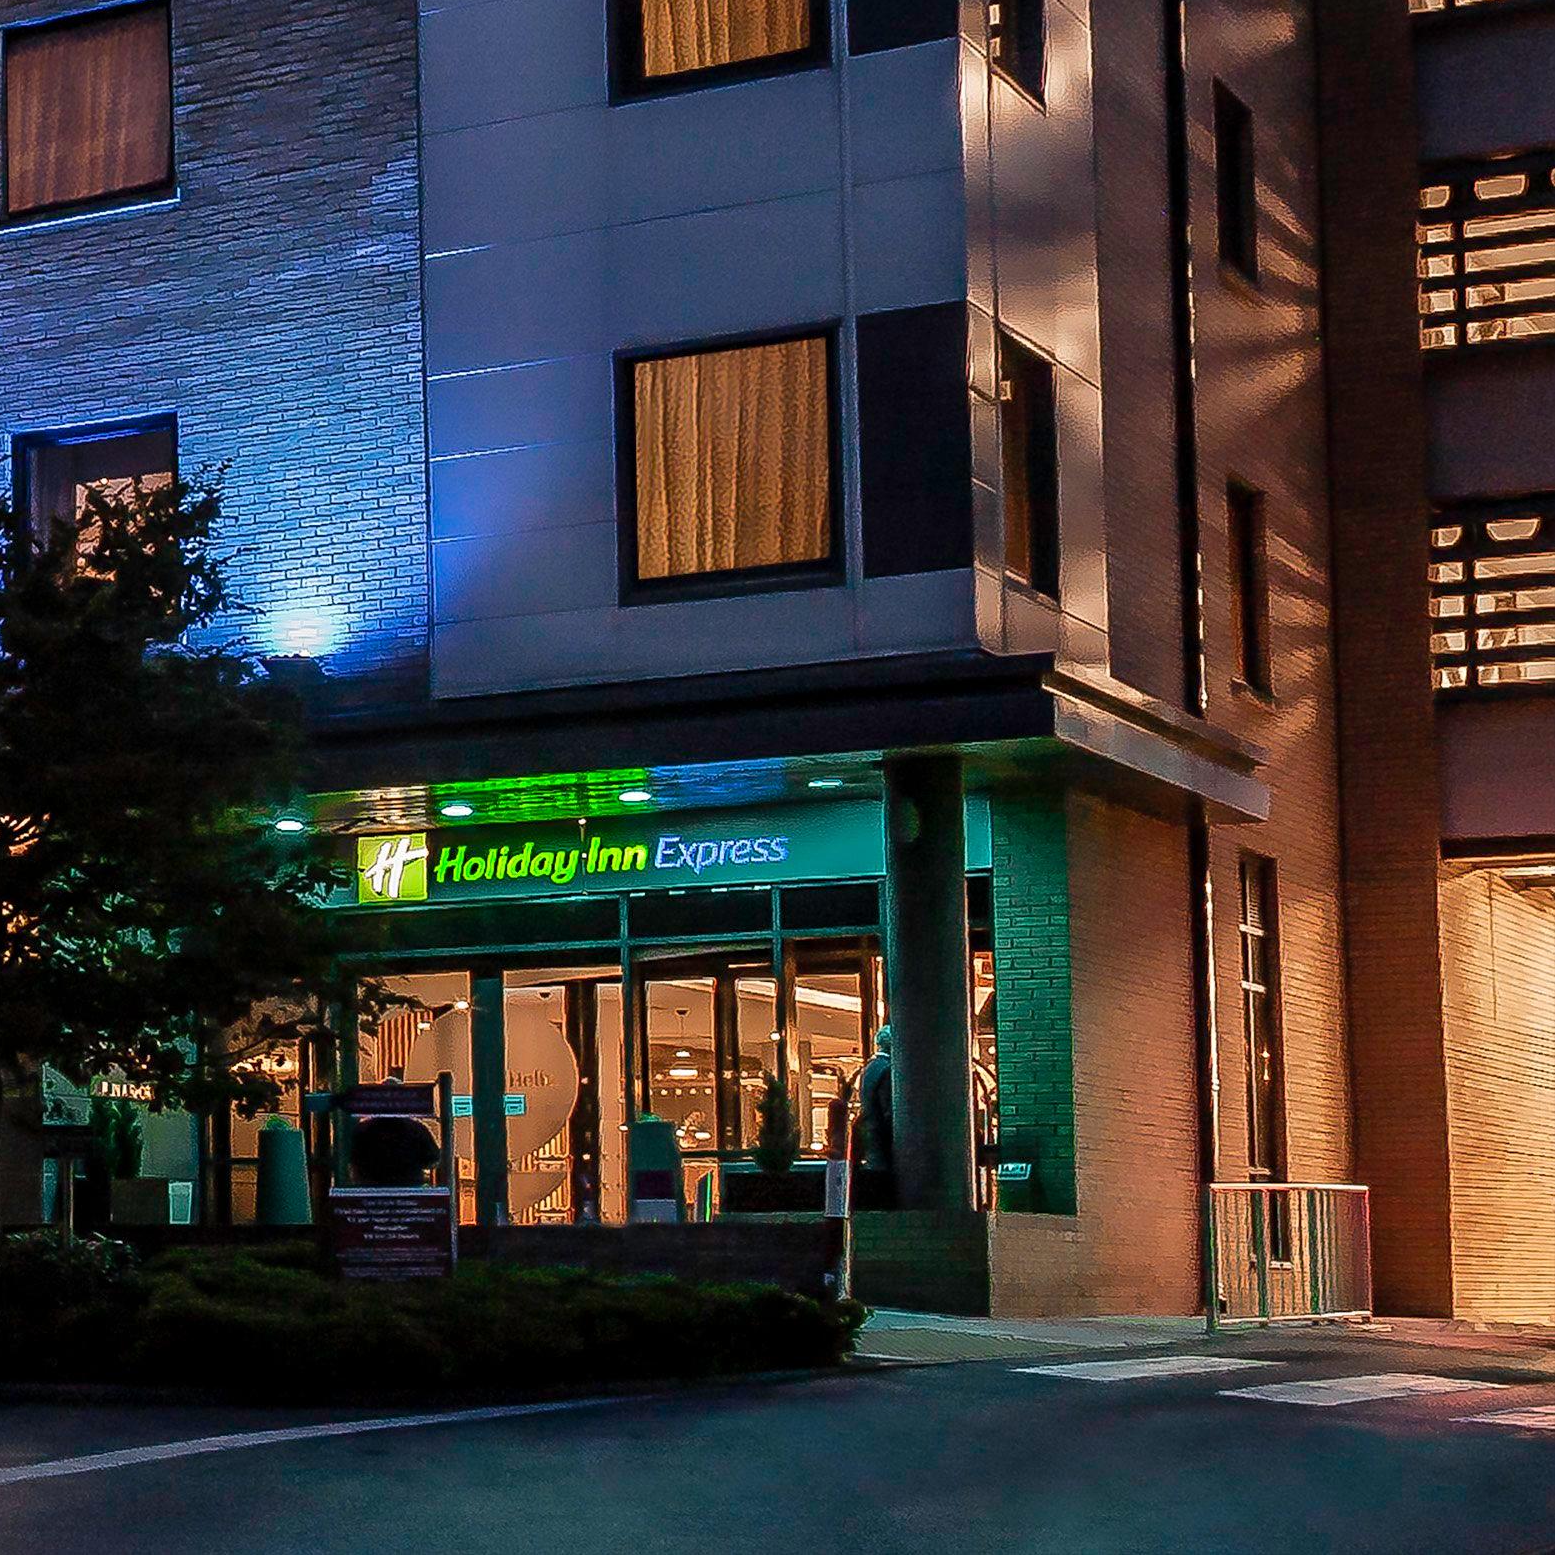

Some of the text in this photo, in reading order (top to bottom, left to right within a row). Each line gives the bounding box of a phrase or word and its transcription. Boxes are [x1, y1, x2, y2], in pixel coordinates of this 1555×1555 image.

[364, 835, 788, 899] H Holiday Inn Express
